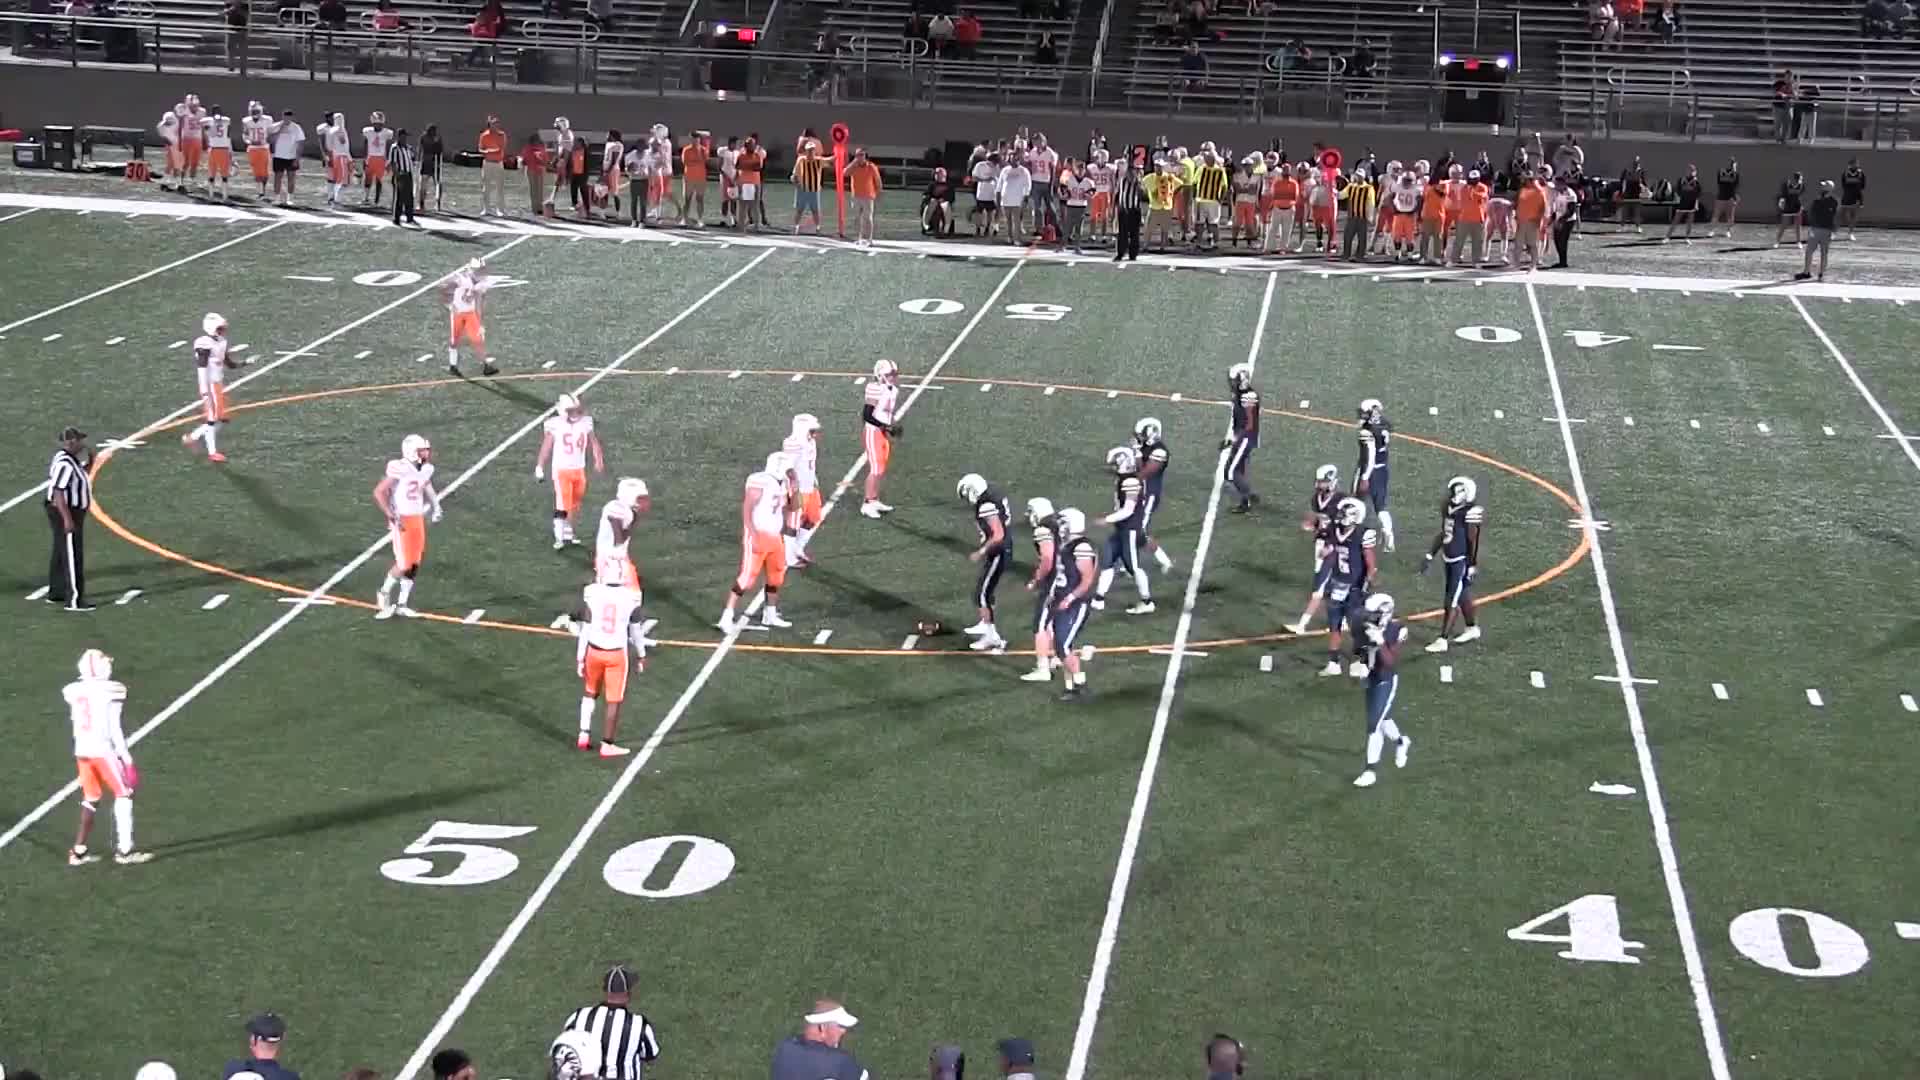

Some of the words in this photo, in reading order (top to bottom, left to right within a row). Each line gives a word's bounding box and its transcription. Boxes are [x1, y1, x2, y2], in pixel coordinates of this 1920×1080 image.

[1133, 146, 1146, 168] 2
[127, 162, 143, 181] 30
[562, 432, 586, 455] 54
[601, 603, 616, 634] 9
